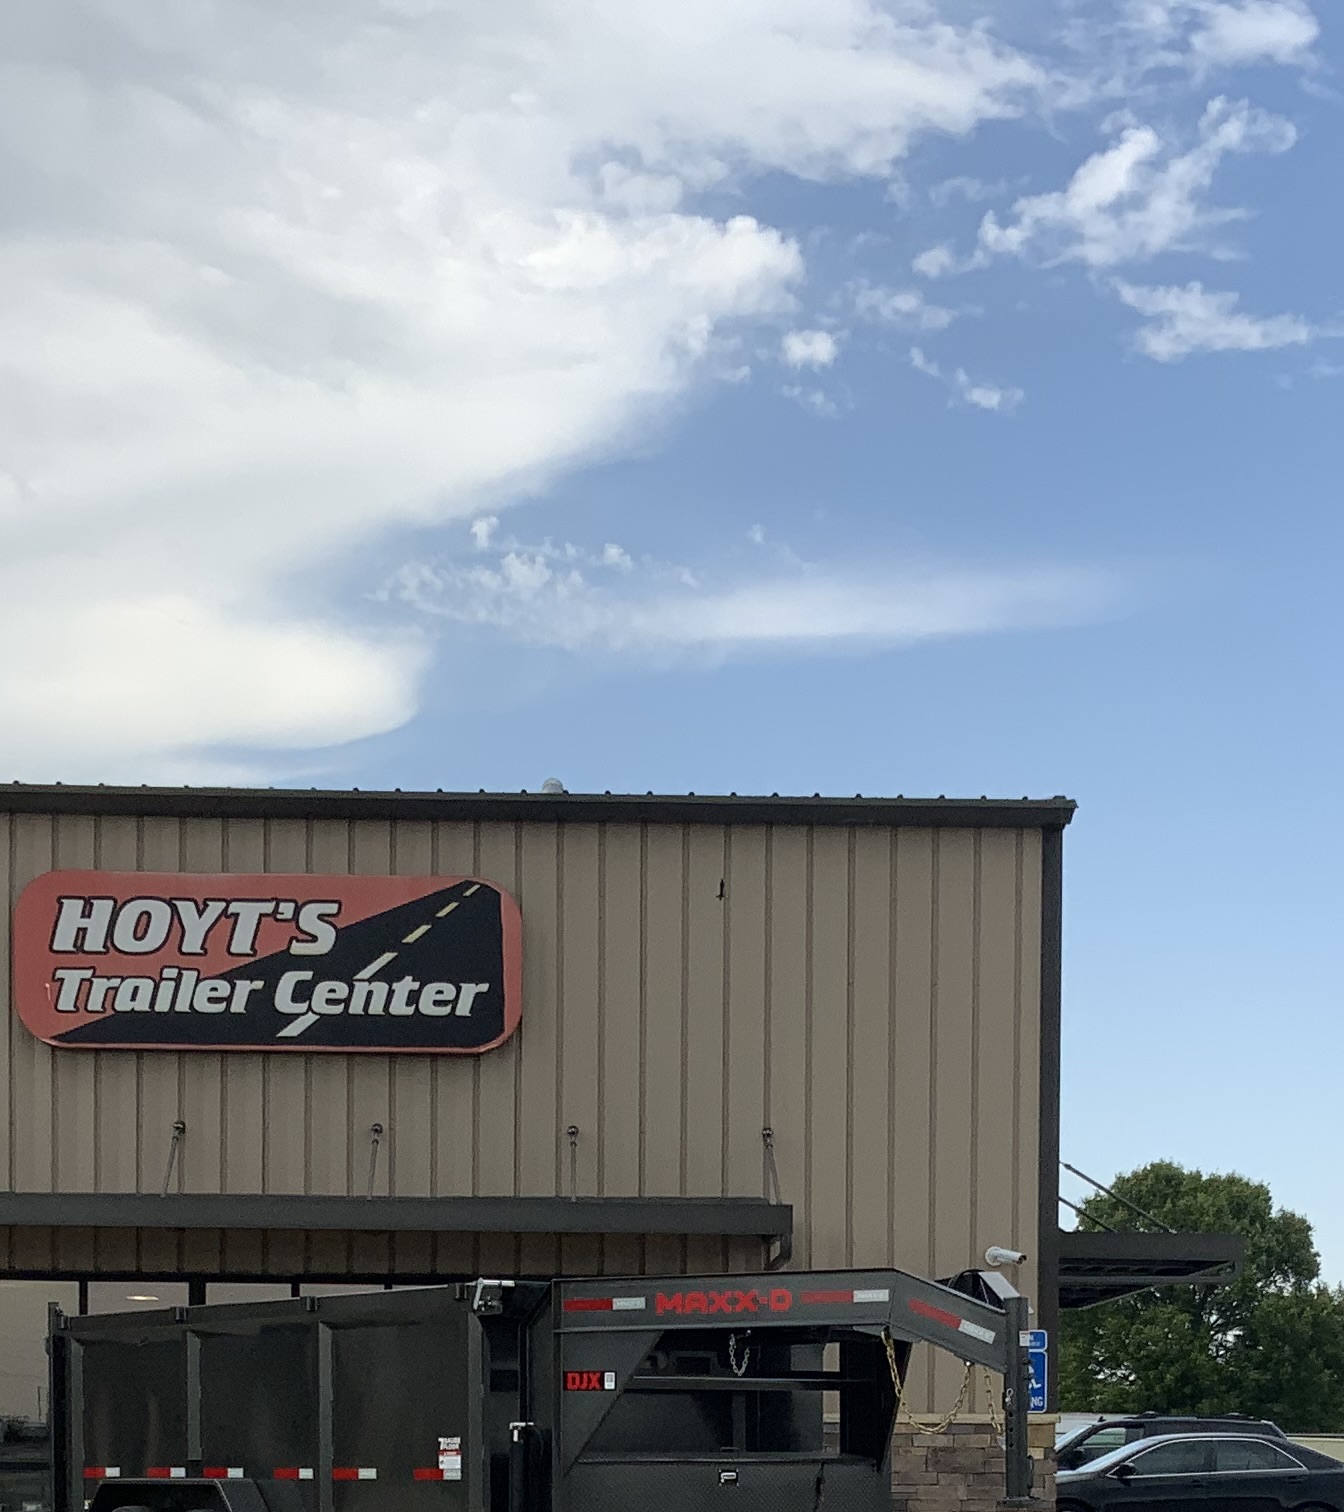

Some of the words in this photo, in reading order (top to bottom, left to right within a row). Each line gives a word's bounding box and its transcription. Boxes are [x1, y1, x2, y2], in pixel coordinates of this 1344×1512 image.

[49, 896, 343, 956] HOYT'S
[52, 966, 265, 1015] Trailer
[273, 969, 491, 1018] Center
[654, 1288, 794, 1316] MAXX-D
[567, 1372, 601, 1390] DJX
